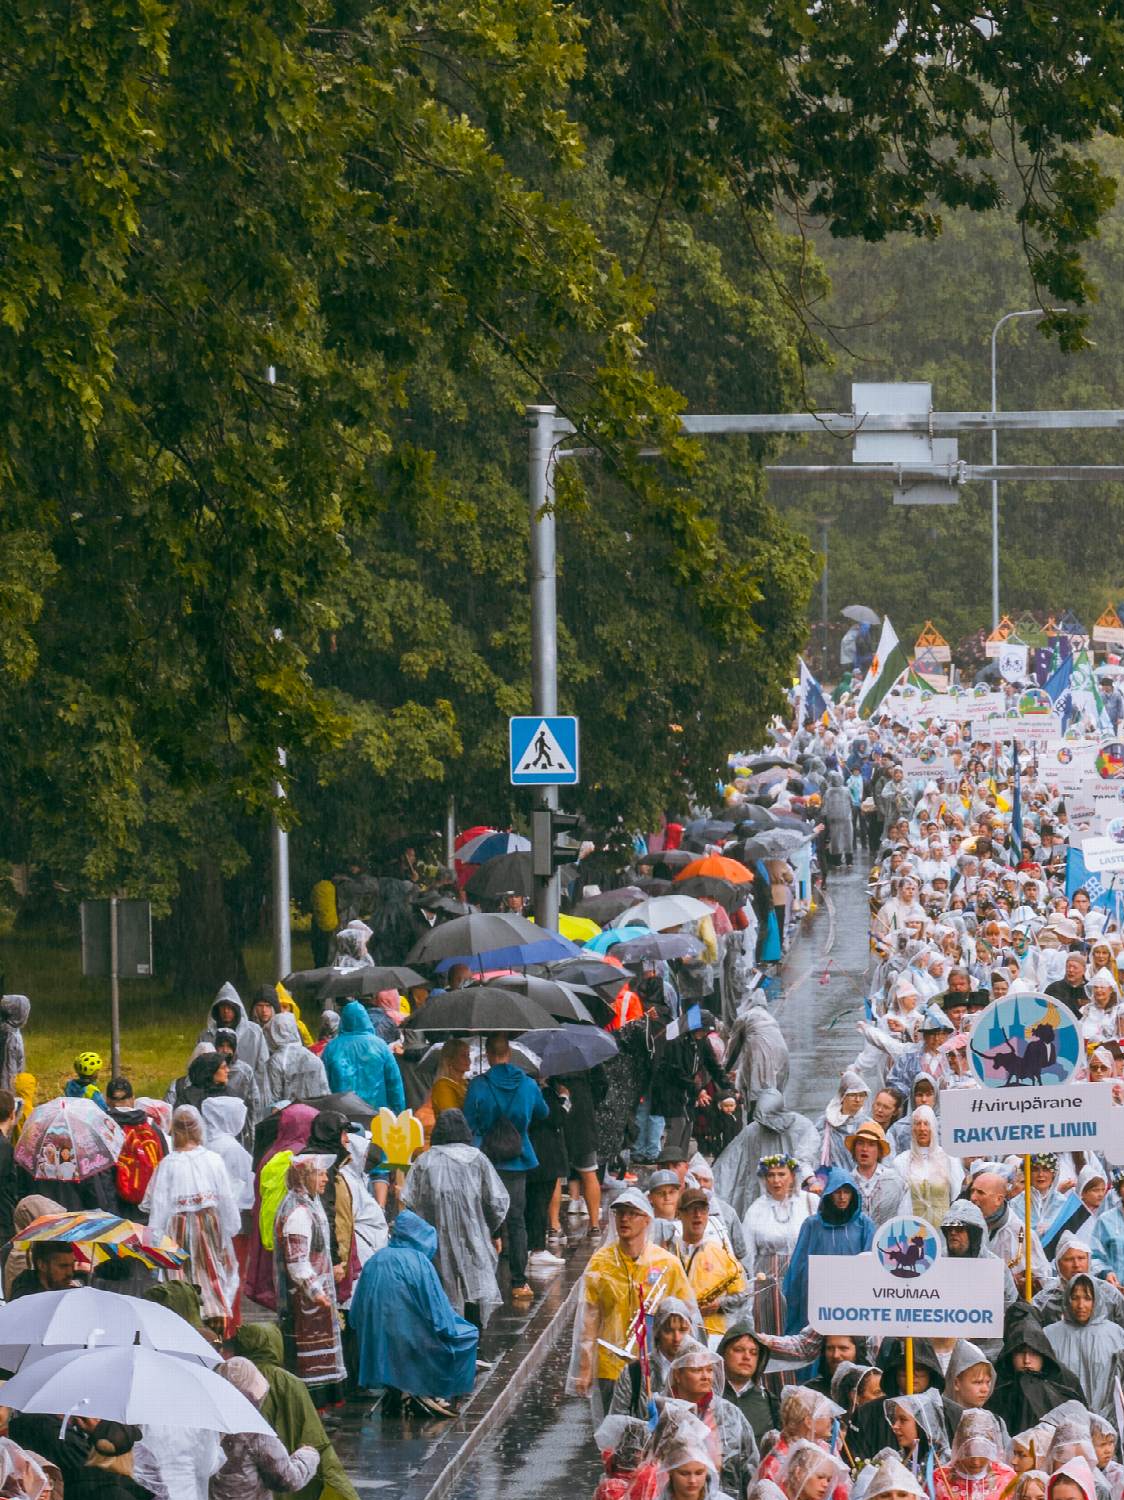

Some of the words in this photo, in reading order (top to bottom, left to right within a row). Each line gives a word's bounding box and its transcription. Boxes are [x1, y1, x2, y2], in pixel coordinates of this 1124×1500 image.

[971, 1096, 1083, 1113] #virupärane
[953, 1124, 1046, 1144] RAKVERE
[1049, 1121, 1098, 1138] LINN
[872, 1287, 941, 1300] VIRUMAA
[818, 1306, 892, 1321] NOORTE
[895, 1307, 993, 1323] MEESKOOR
